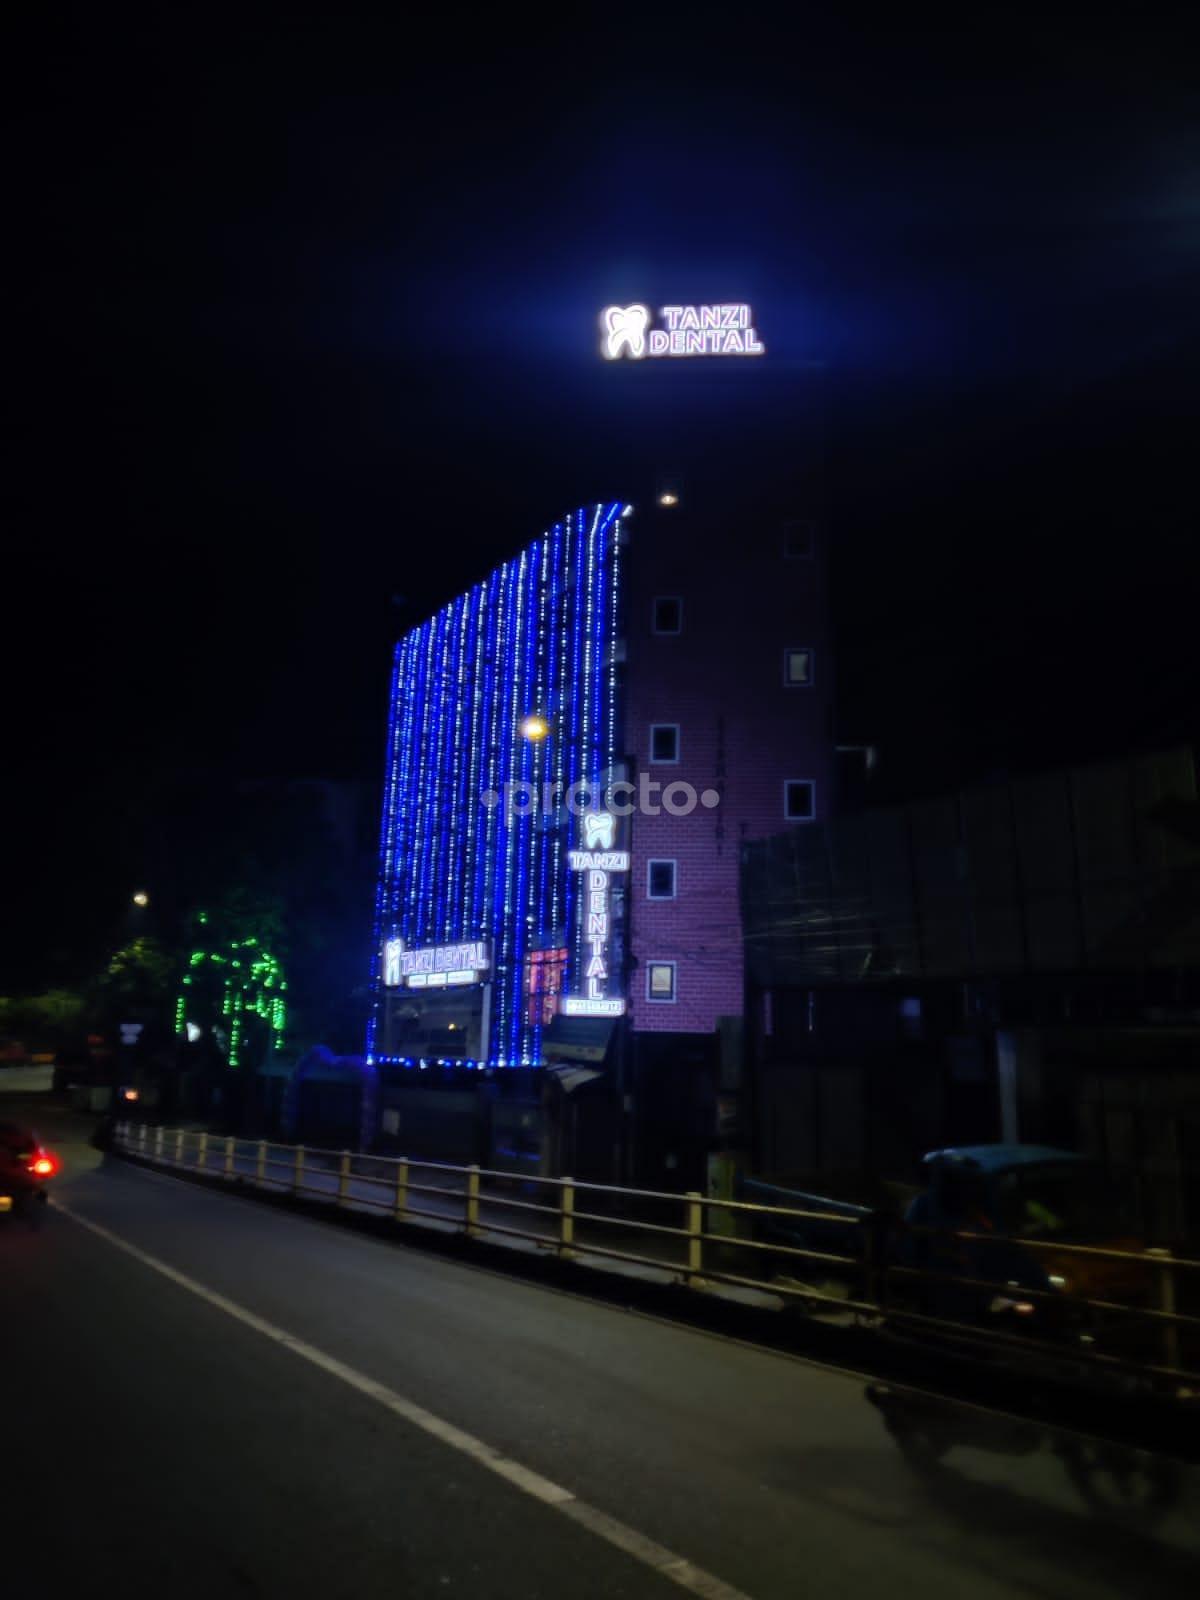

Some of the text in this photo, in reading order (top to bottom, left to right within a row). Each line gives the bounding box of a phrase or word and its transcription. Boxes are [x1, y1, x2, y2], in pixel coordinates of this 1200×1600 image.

[662, 305, 751, 330] TANZI
[649, 328, 765, 354] DENTAL
[570, 851, 628, 871] TANZI
[587, 871, 608, 1000] DENTAL
